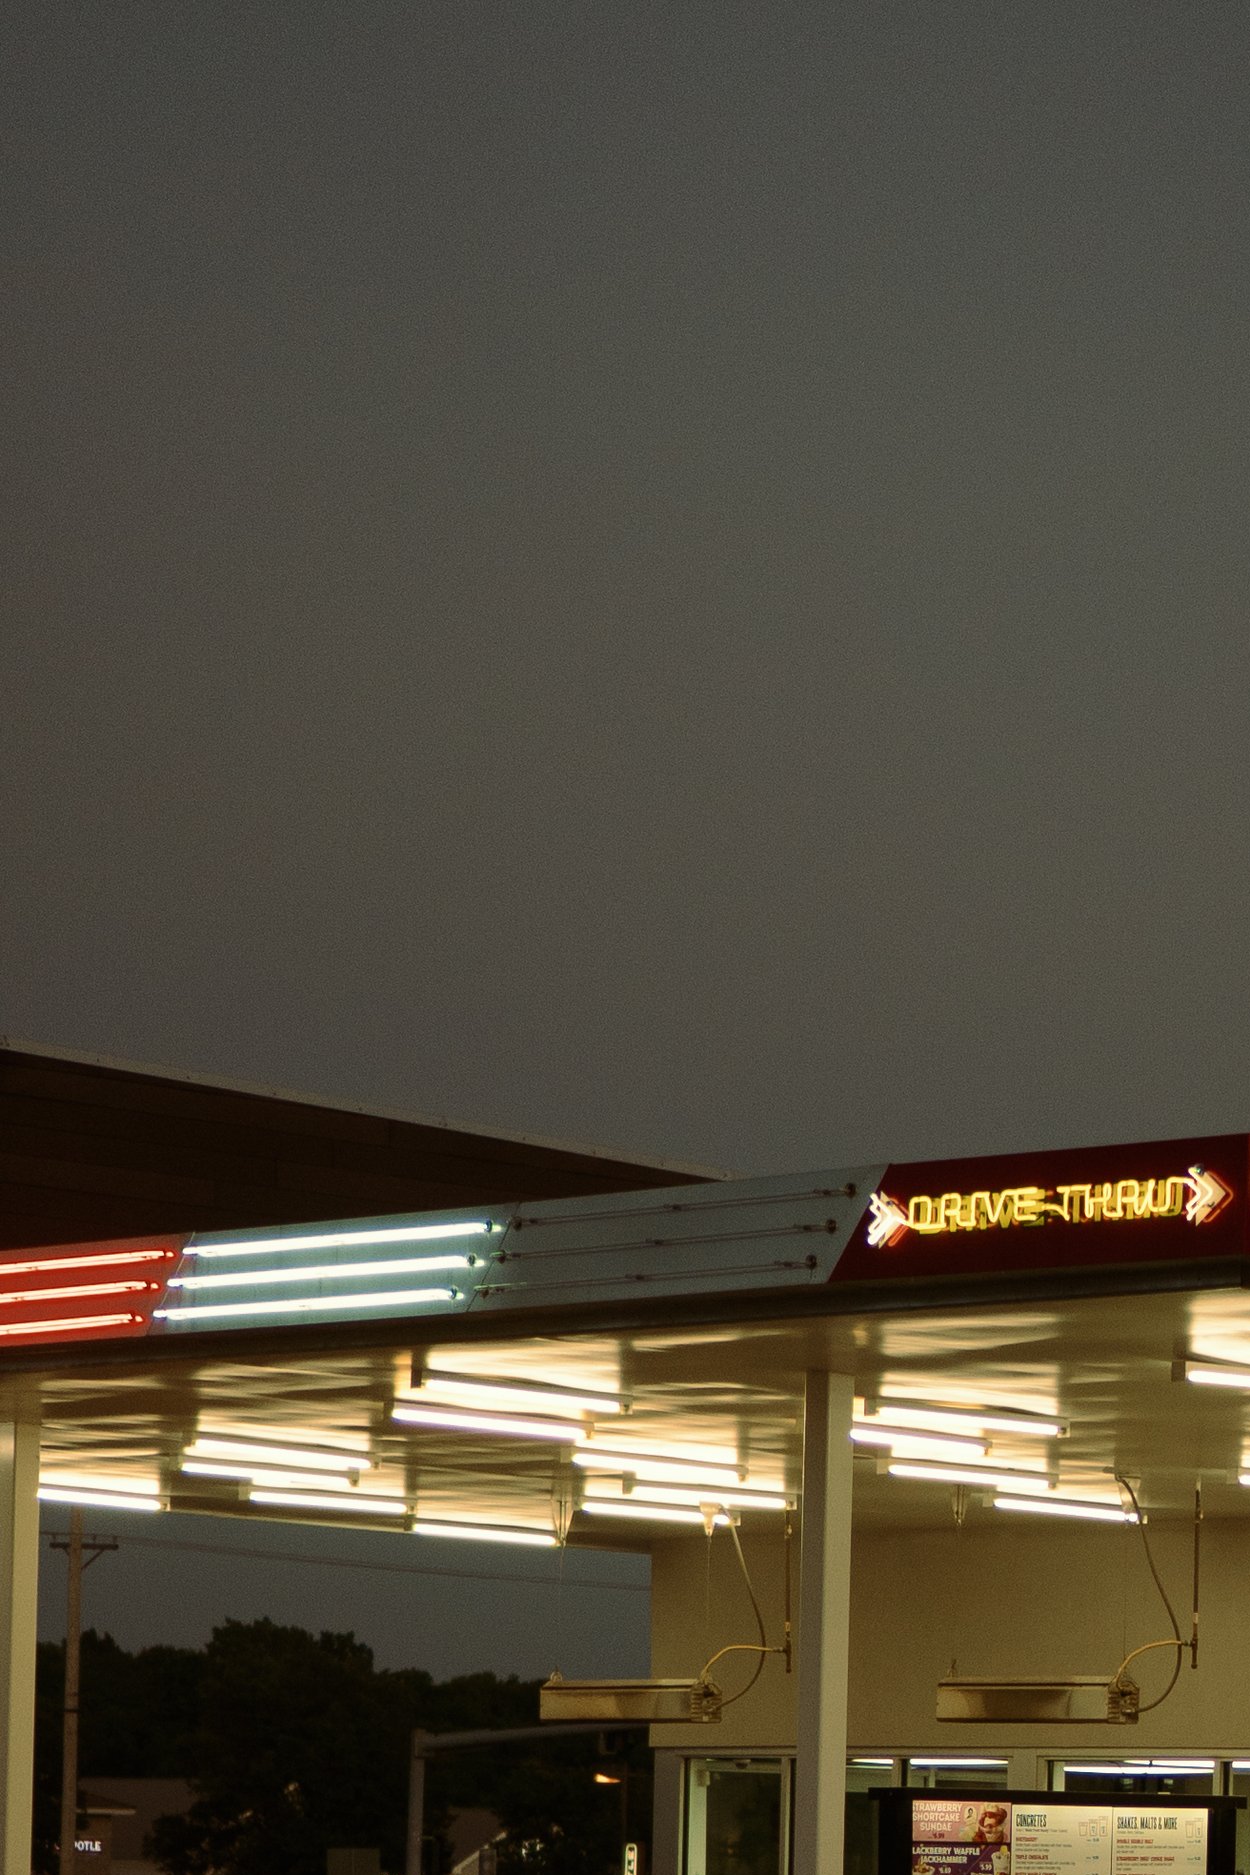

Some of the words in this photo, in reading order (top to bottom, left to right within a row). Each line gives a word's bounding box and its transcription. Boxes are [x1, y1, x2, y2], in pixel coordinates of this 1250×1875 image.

[908, 1176, 1187, 1235] DRIVE-THRU
[913, 1812, 961, 1822] SHORTCAKE
[1015, 1814, 1047, 1827] CONCRETES
[919, 1821, 952, 1831] SUNDAE
[1140, 1817, 1158, 1830] MALTS
[1164, 1817, 1178, 1830] MORE
[912, 1846, 951, 1855] LACKBERRY
[953, 1847, 980, 1856] WAFFLE
